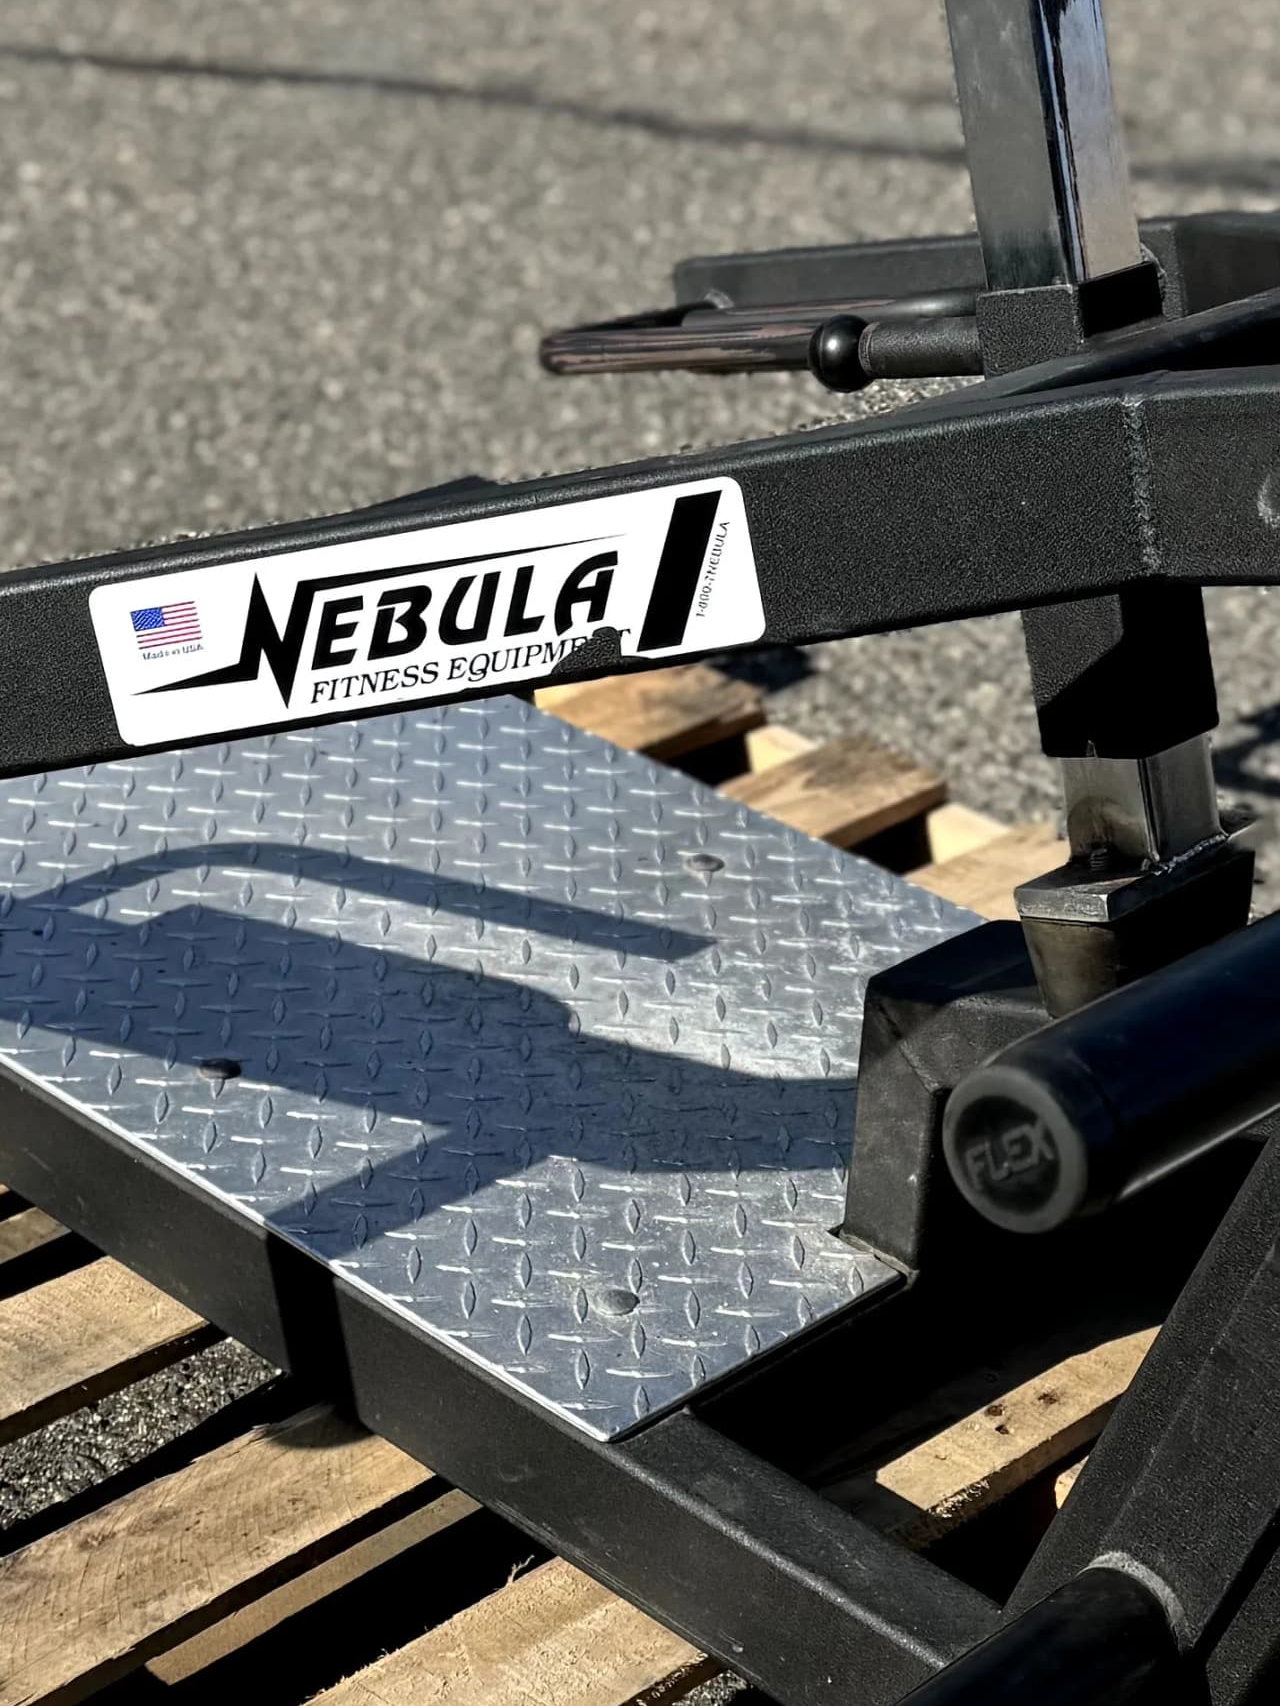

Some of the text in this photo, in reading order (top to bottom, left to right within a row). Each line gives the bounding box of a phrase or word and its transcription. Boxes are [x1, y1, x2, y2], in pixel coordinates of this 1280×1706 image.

[195, 543, 621, 708] NEBULA
[310, 664, 440, 705] FITNESS
[966, 1120, 1055, 1192] FLEX
